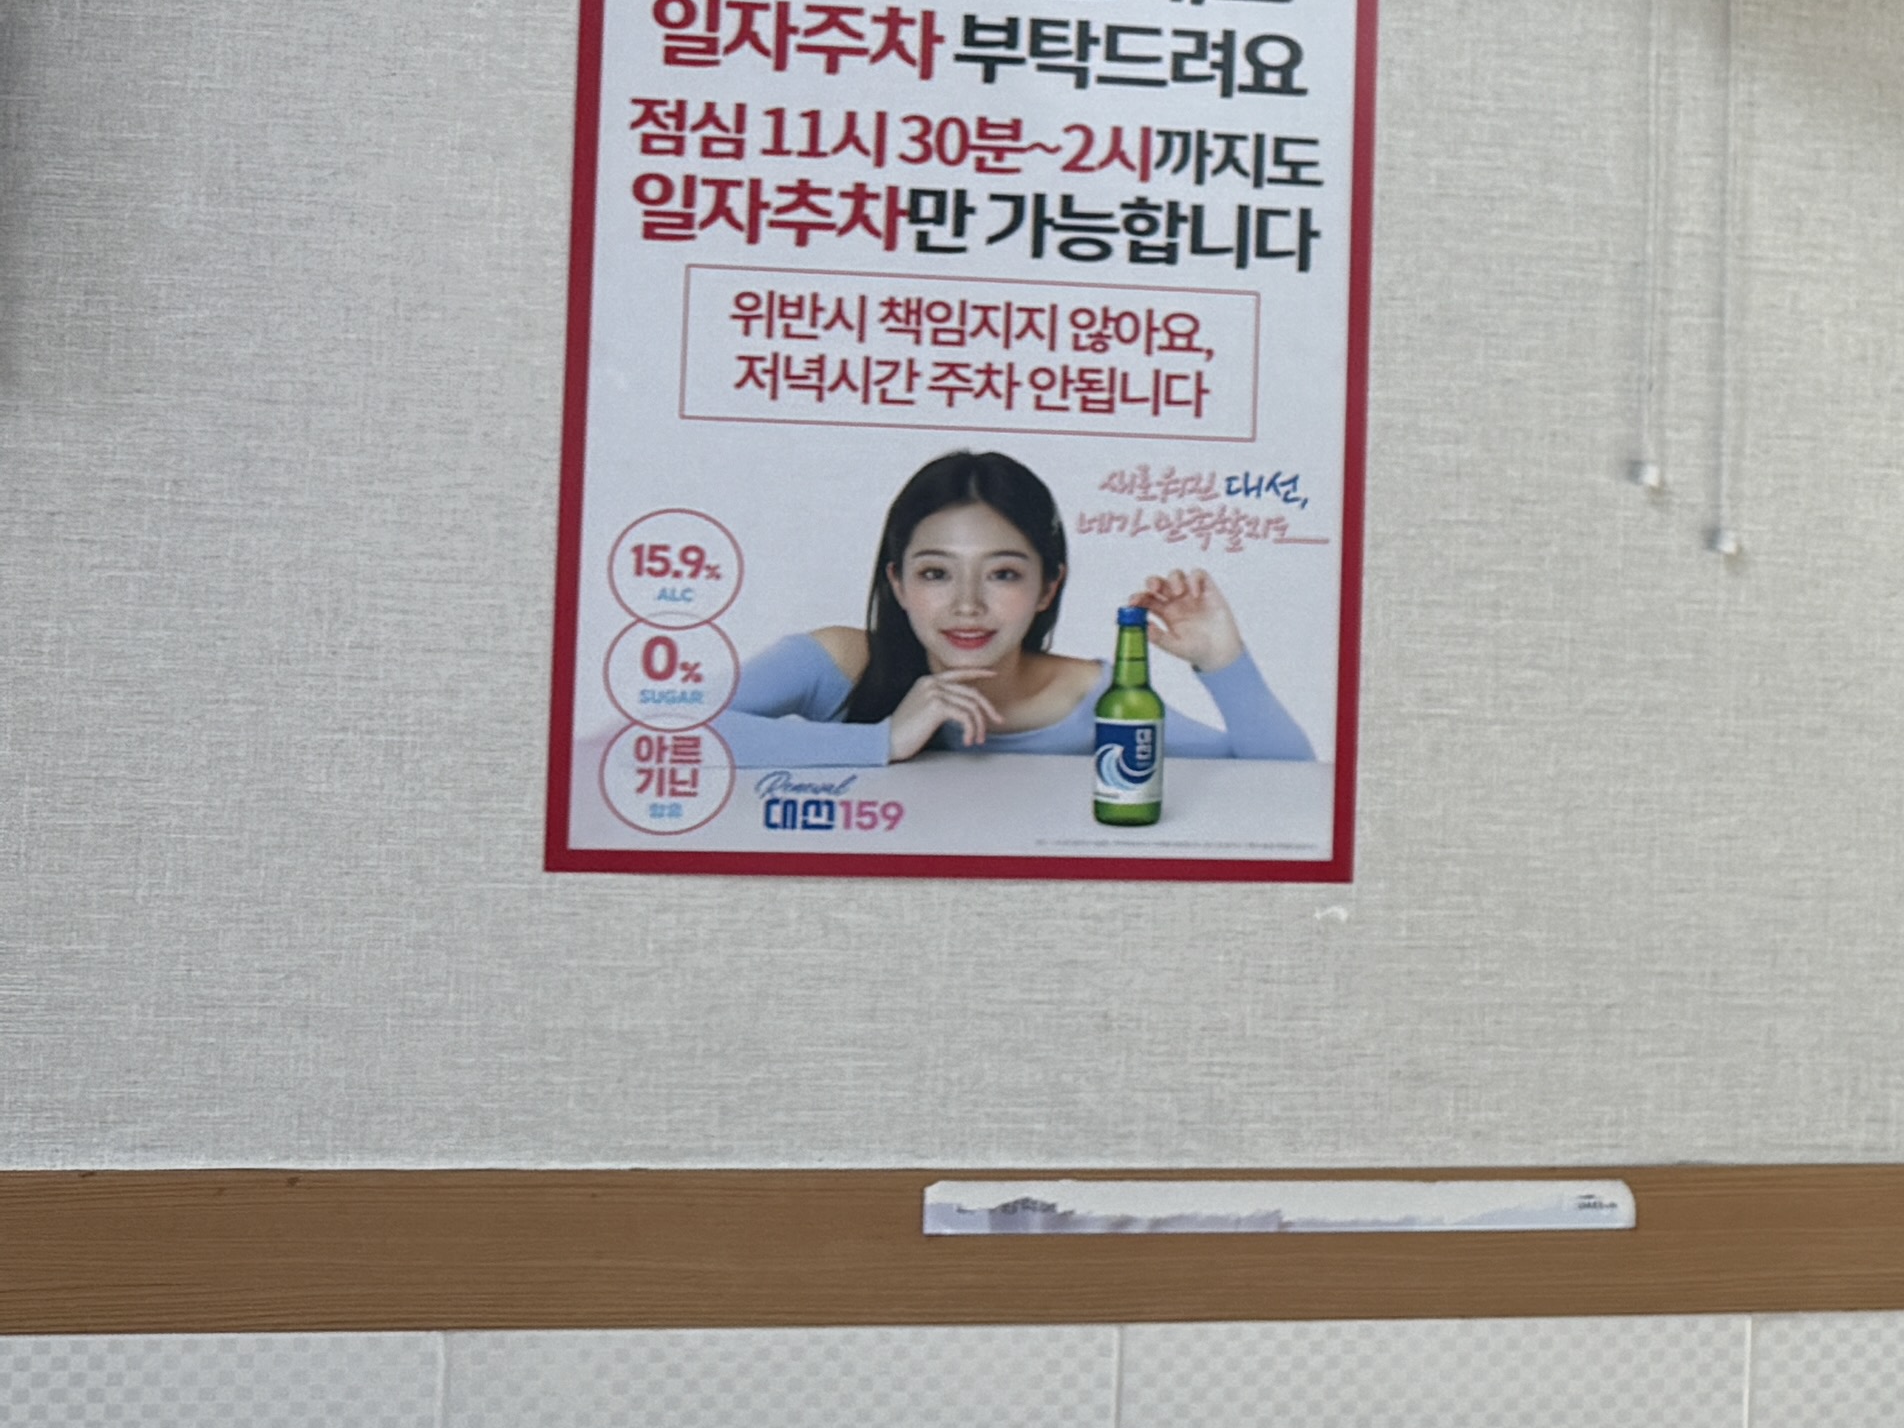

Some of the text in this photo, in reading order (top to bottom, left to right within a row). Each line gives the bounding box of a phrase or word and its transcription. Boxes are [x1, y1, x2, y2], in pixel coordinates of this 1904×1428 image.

[953, 13, 1308, 98] 부탁드려요
[629, 97, 1325, 188] 점심 11시 30분~2시까지도
[631, 173, 1322, 272] 일자추차만 가능합니다
[730, 291, 1215, 361] 위반시 책임지지 않아요,
[733, 356, 1210, 418] 저녁시간 주차 안됩니다
[1225, 470, 1309, 509] 대선,
[631, 543, 722, 581] 15.9%
[657, 587, 694, 602] ALC
[642, 635, 704, 683] 0%
[640, 689, 704, 705] SUGAR
[633, 735, 702, 764] 아르
[635, 767, 699, 797] 기닌
